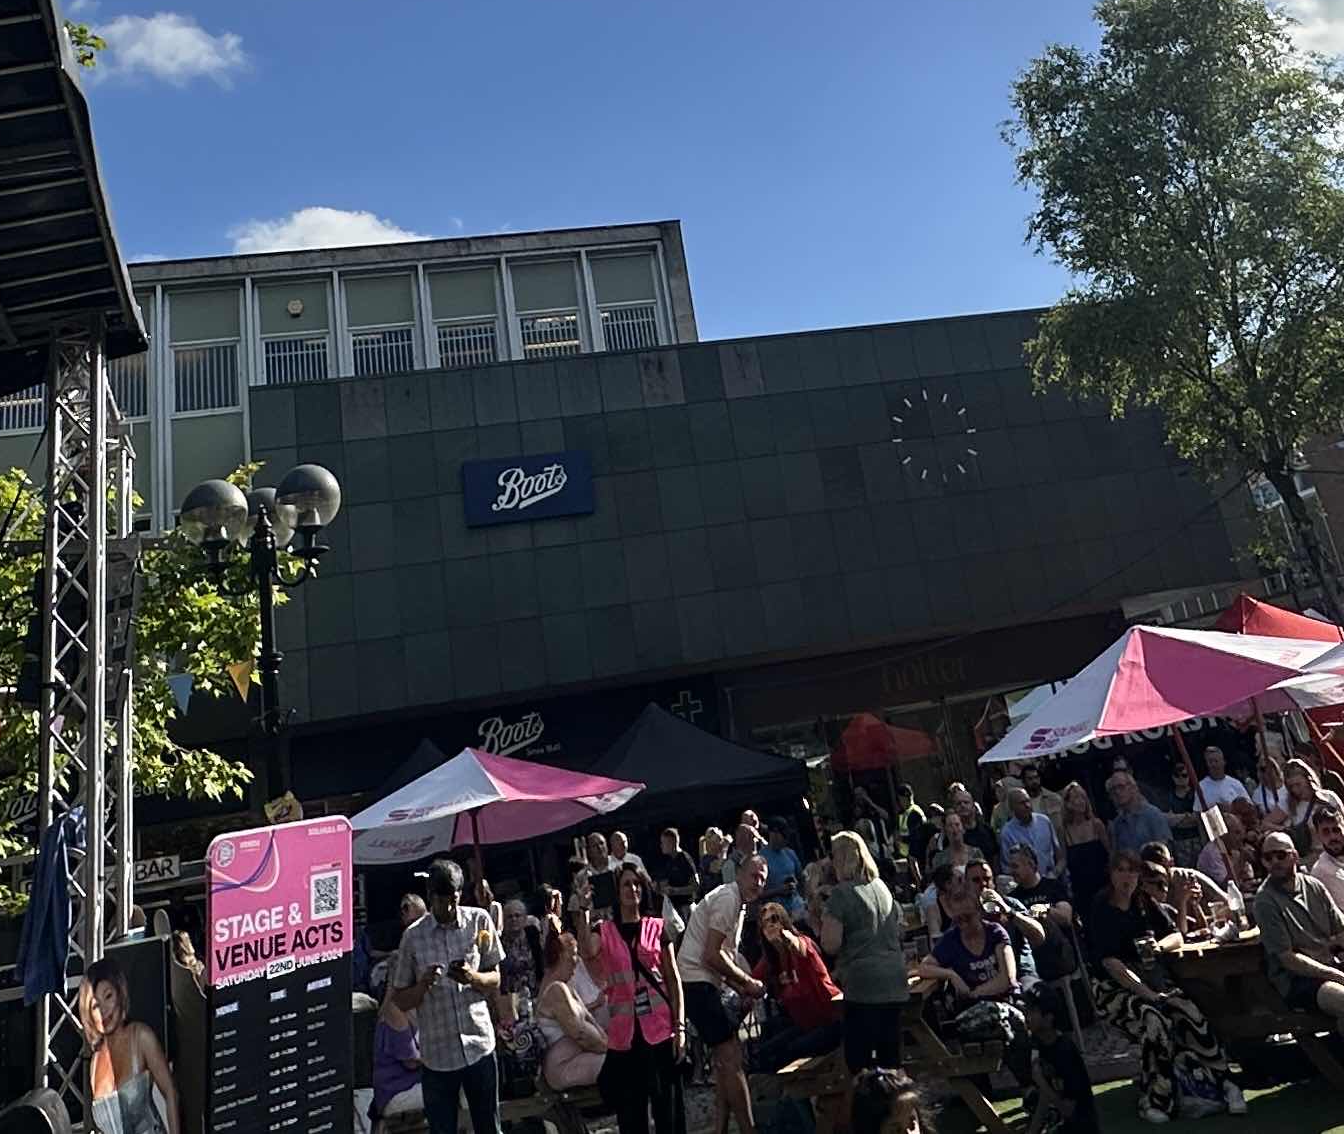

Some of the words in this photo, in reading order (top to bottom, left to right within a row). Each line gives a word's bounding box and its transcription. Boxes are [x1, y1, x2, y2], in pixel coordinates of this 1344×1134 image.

[492, 464, 567, 511] Boots
[478, 712, 544, 756] Boots
[135, 858, 174, 880] BAR
[214, 906, 284, 943] STAGE
[288, 902, 303, 926] &
[215, 932, 287, 972] VENUE
[291, 921, 343, 953] ACTS
[216, 968, 266, 990] SATURDAY
[269, 959, 295, 975] 22ND
[297, 954, 321, 969] JUNE
[321, 948, 344, 962] 2024
